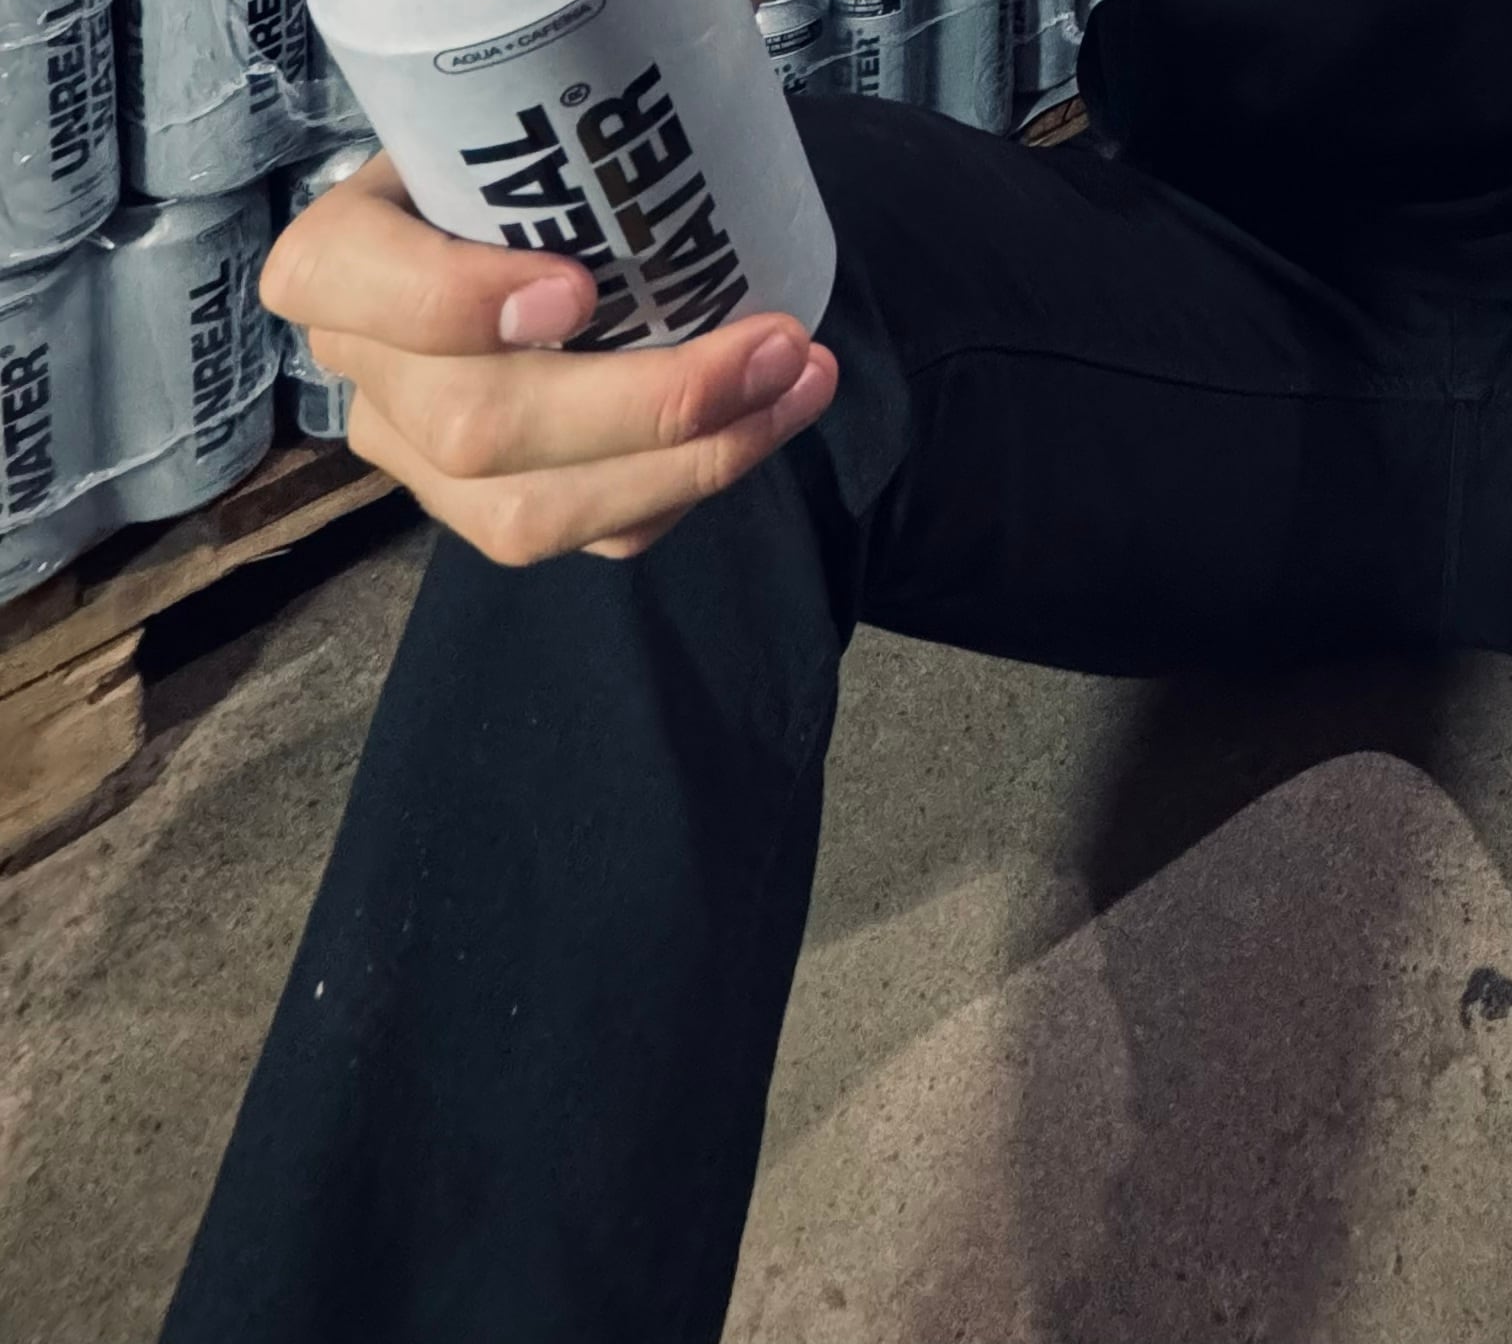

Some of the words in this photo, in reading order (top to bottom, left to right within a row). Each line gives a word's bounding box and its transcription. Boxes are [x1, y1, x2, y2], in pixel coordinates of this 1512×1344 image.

[576, 63, 750, 344] WATER
[0, 343, 51, 513] WATER
[188, 261, 236, 463] UNREAL
